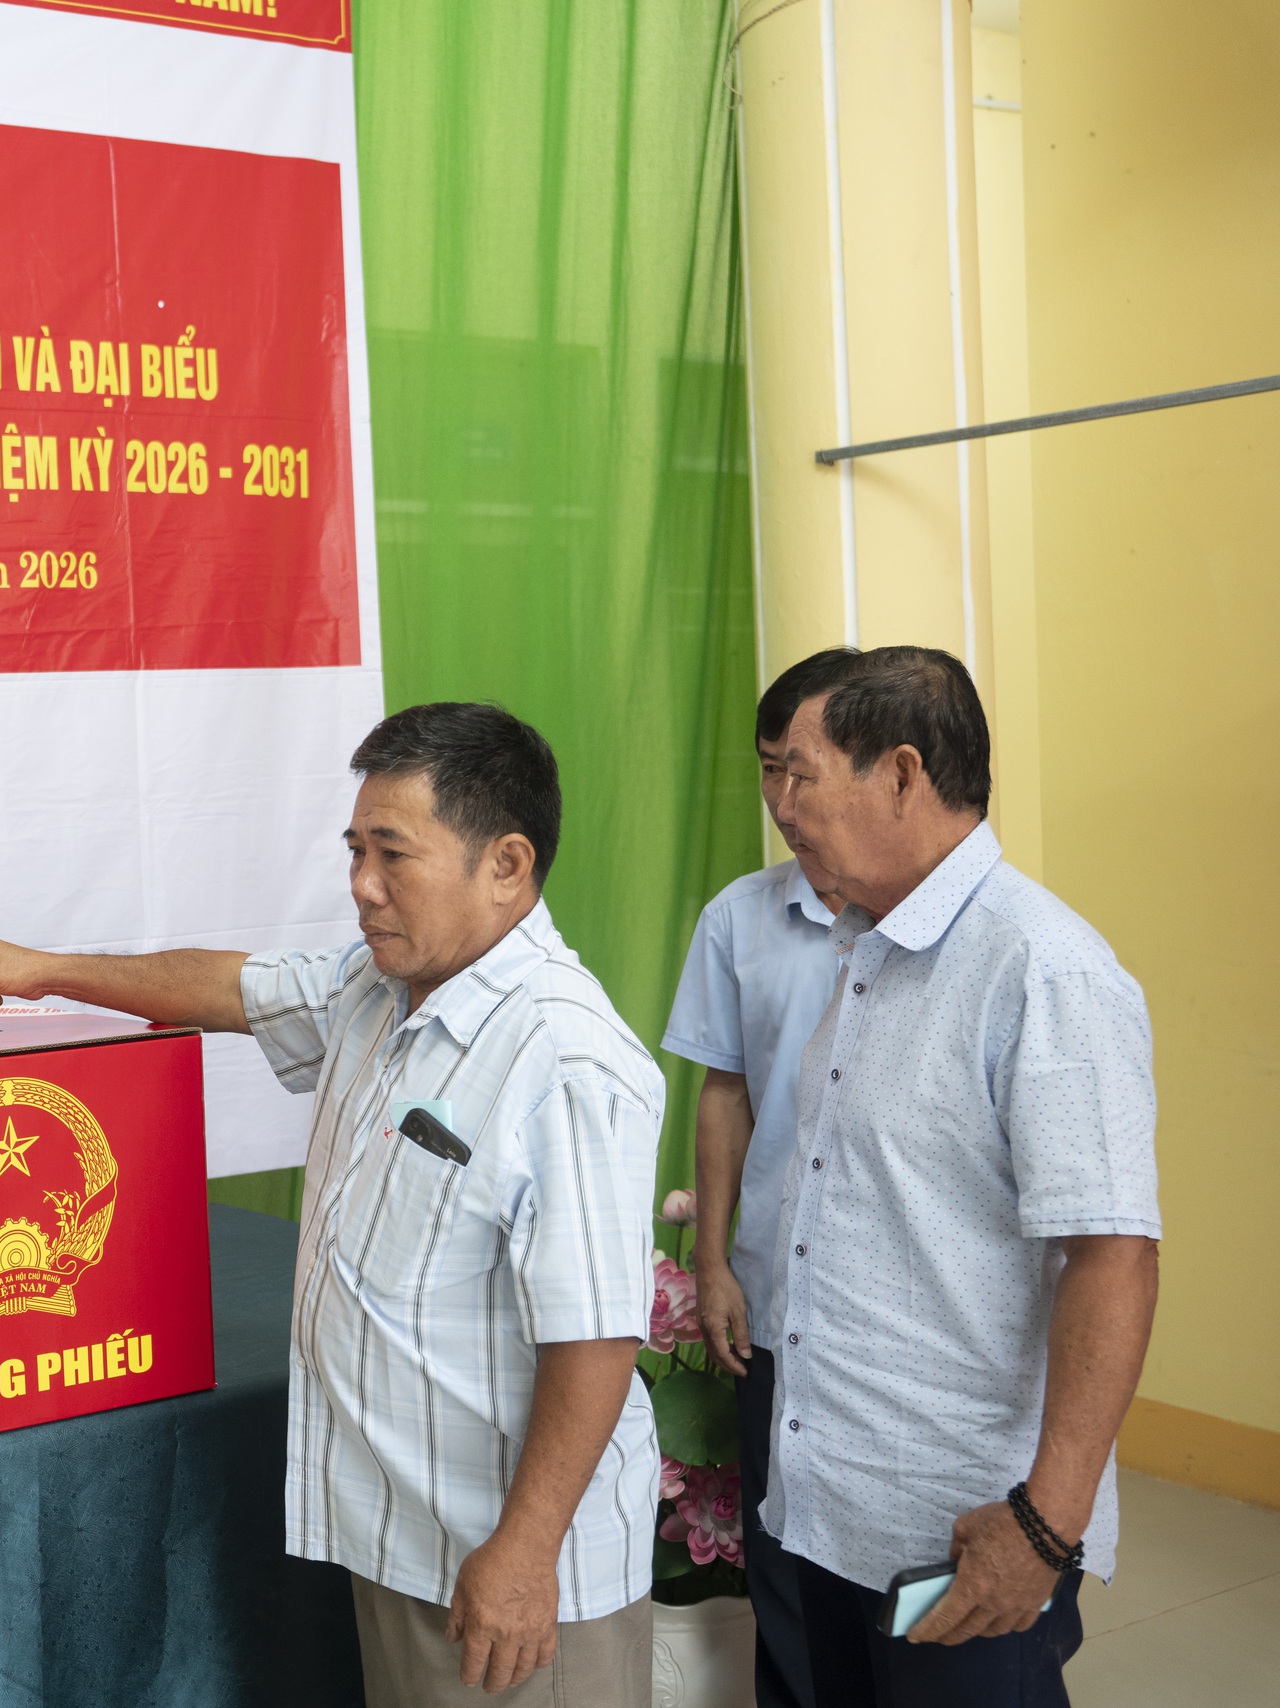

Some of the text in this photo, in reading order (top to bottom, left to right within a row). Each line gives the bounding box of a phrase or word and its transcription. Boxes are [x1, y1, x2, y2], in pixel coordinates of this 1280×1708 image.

[11, 325, 62, 393] VÀ
[69, 339, 131, 408] ĐẠI
[140, 324, 219, 401] BIỂU
[69, 426, 114, 492] KỲ
[125, 439, 209, 496] 2026
[218, 466, 233, 479] -
[242, 443, 309, 499] 2031
[19, 550, 99, 590] 2026
[15, 1272, 27, 1281] HỘI
[28, 1271, 41, 1280] CHỦ
[42, 1273, 61, 1285] NGHĨA
[19, 1282, 47, 1294] NAM
[36, 1328, 153, 1392] PHIẾU
